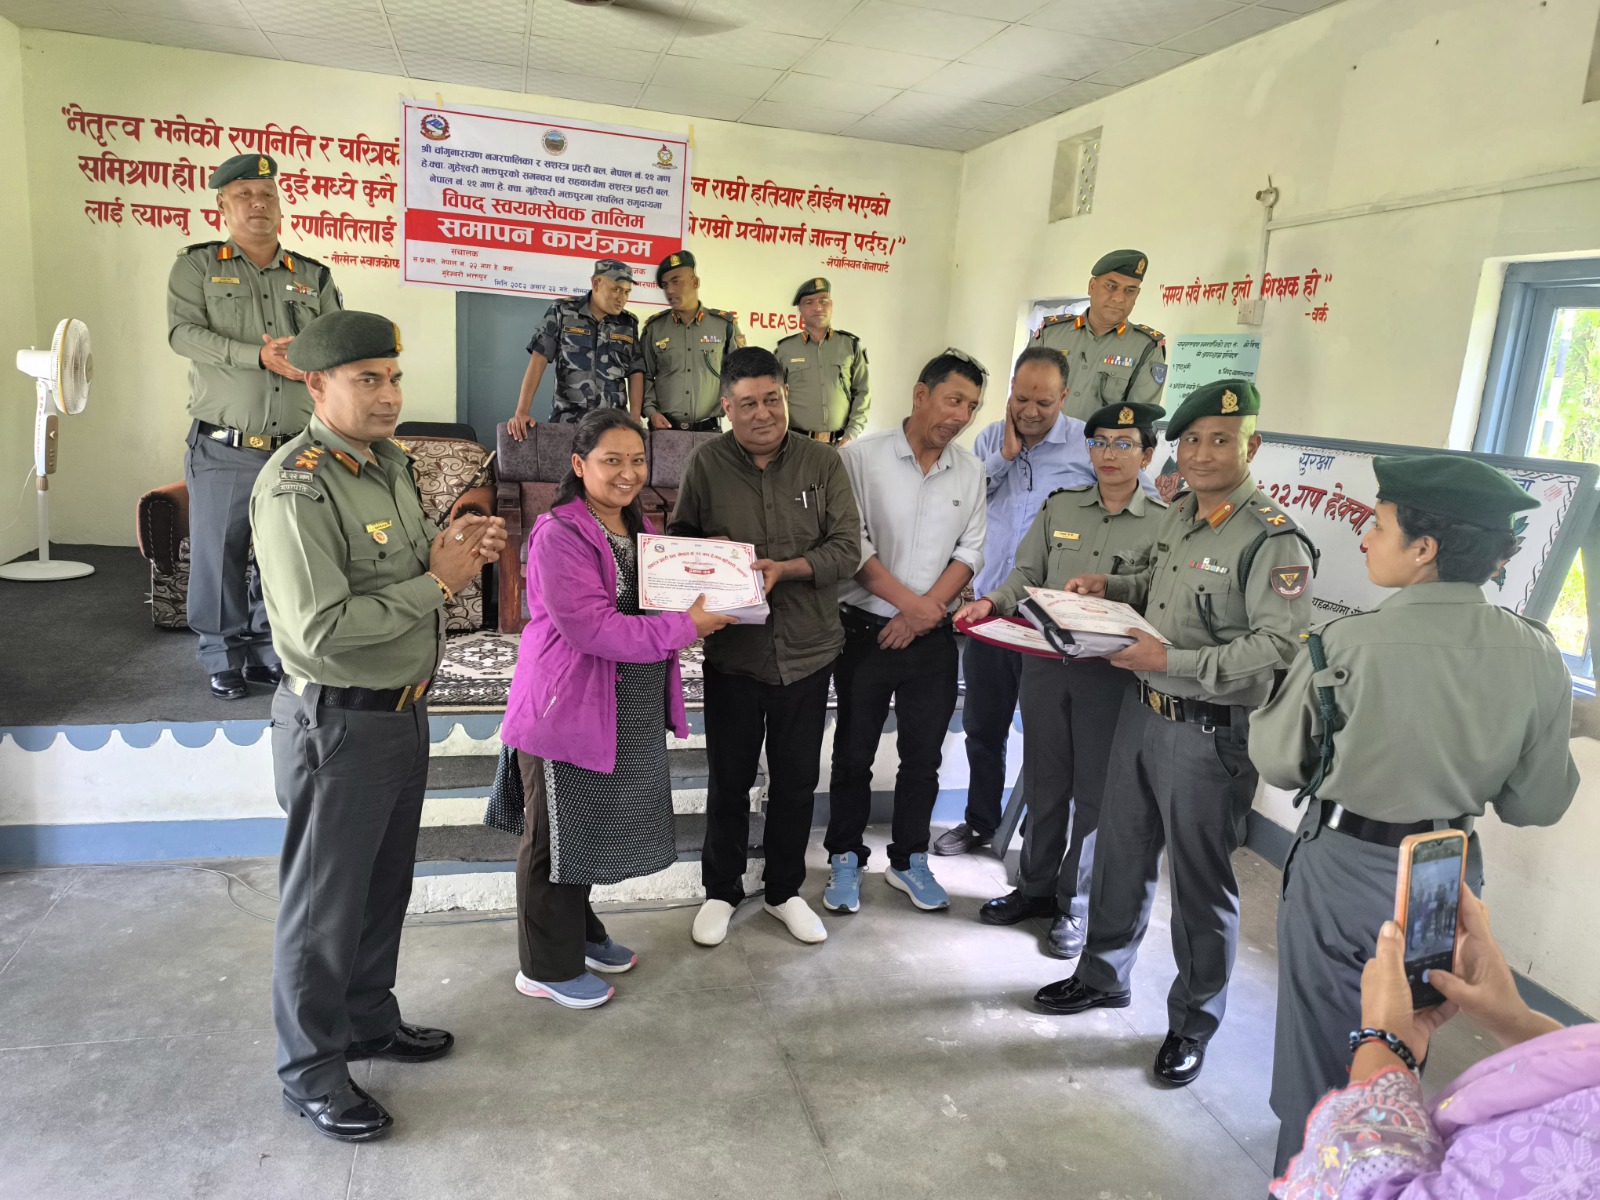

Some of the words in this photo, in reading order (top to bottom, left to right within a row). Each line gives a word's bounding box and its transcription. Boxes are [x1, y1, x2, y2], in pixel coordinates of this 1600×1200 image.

[150, 114, 224, 149] भनेको
[228, 123, 316, 161] रणनिति
[319, 136, 334, 162] र
[338, 133, 400, 167] चरित्रक
[421, 144, 432, 154] श्री
[485, 153, 533, 166] नगरपालिका
[544, 160, 569, 170] सशस्त्र
[572, 164, 591, 173] प्रहरी
[610, 167, 632, 178] नेपाल
[645, 173, 655, 181] २२
[657, 174, 671, 183] गण
[448, 162, 479, 173] गुहेश्वरी
[481, 166, 519, 178] भक्तपुरको
[522, 171, 552, 182] समन्वय
[555, 175, 565, 184] एवं
[568, 177, 606, 188] सहकार्यमा
[608, 182, 633, 192] सशस्त्र
[635, 185, 654, 194] प्रहरी
[278, 168, 311, 205] दुई
[311, 172, 358, 201] मध्ये
[361, 173, 398, 207] कुनै
[429, 173, 453, 184] नेपाल
[467, 179, 477, 187] २२
[480, 181, 494, 189] गण
[525, 185, 555, 197] गुहेश्वरी
[557, 190, 593, 202] भक्तपुरमा
[626, 199, 662, 209] समुदायमा
[751, 180, 806, 210] हतियार
[807, 184, 846, 213] होईन
[847, 192, 891, 219] भएको
[85, 197, 125, 228] लाई
[130, 203, 191, 236] त्याग्नु
[291, 210, 397, 247] रणनितिलाई
[441, 187, 486, 214] विपद्
[491, 199, 587, 223] स्वयमसेवक
[591, 207, 645, 229] तालिम
[437, 217, 535, 245] समापन
[541, 229, 653, 258] कार्यक्रम
[699, 214, 733, 240] राम्रो
[735, 217, 779, 244] प्रयोग
[779, 223, 807, 246] गर्न
[809, 228, 851, 255] जान्नु
[1203, 282, 1229, 305] भन्दा
[1231, 274, 1253, 306] ठुलो
[1261, 272, 1300, 302] शिक्षक
[1292, 484, 1327, 515] गण
